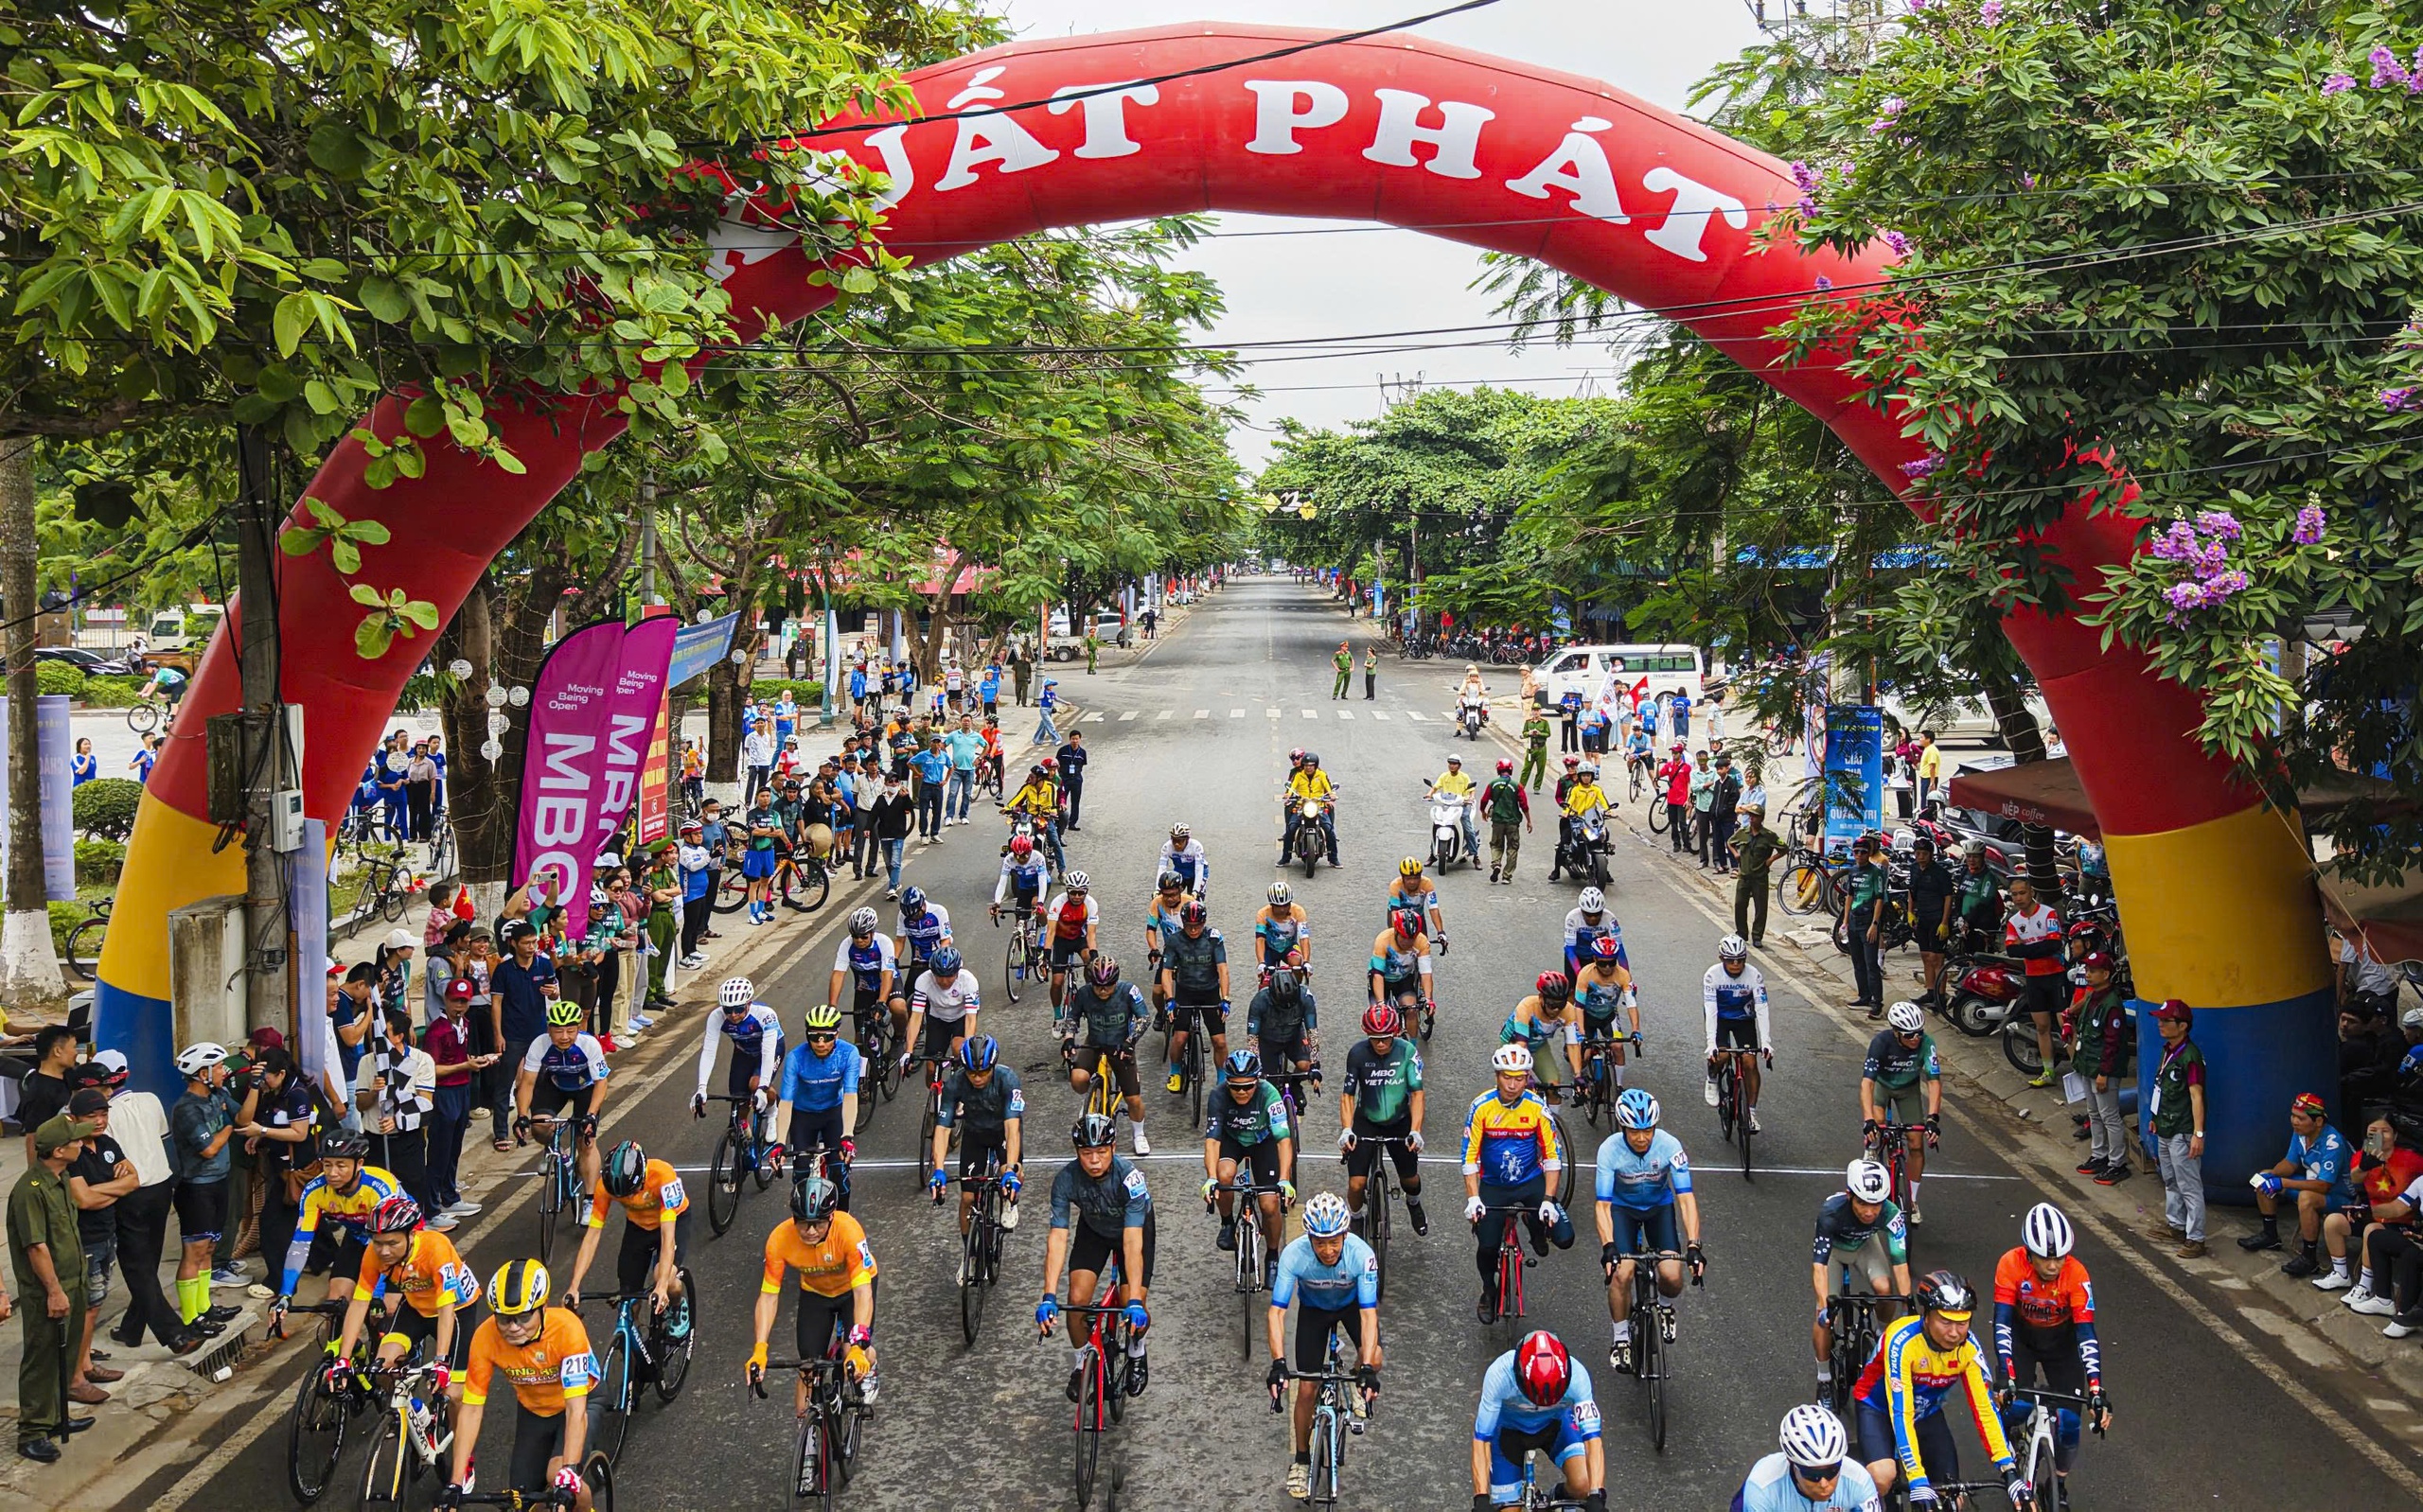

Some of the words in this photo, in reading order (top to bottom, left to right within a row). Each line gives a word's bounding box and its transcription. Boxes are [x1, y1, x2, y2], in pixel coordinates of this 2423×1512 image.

[1244, 79, 1748, 262] PHÁT
[626, 669, 658, 682] Moving
[567, 683, 604, 695] Moving
[615, 685, 635, 695] pen
[618, 677, 645, 690] Being
[548, 700, 577, 711] Open
[557, 692, 589, 704] Being
[2021, 806, 2046, 821] coffee
[1371, 1069, 1396, 1078] MBO
[1233, 1116, 1257, 1125] MBO
[530, 1274, 544, 1305] LAZER
[631, 1325, 652, 1364] PARDUS
[1994, 1323, 2013, 1356] IAM
[2079, 1338, 2101, 1375] IAM
[565, 1357, 588, 1376] 218
[1575, 1402, 1600, 1422] 226
[408, 1411, 428, 1450] DOGMA
